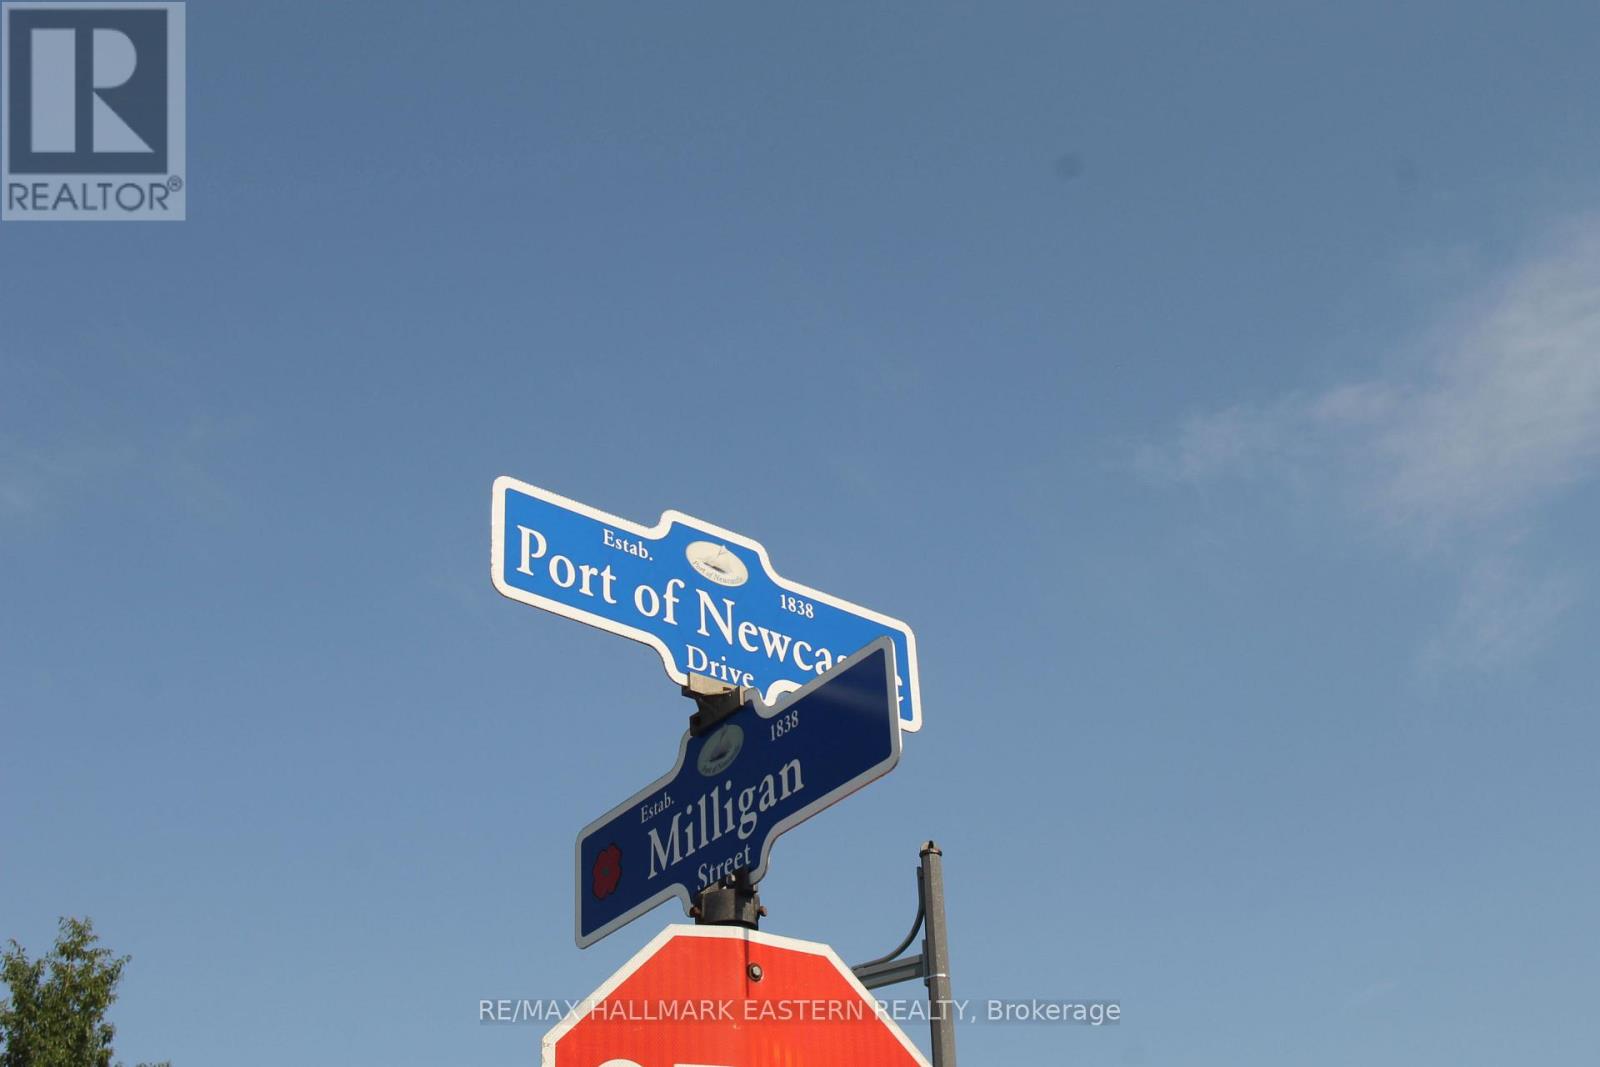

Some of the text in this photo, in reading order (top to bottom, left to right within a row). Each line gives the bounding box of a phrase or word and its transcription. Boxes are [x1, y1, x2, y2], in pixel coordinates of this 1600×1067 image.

[602, 528, 654, 561] Estab.
[516, 525, 618, 605] Port
[633, 579, 686, 626] of
[779, 594, 815, 619] 1838
[685, 644, 756, 690] Drive
[769, 710, 800, 742] 1838
[639, 792, 675, 824] Estab.
[646, 758, 805, 880] Milligan
[697, 843, 752, 891] Street
